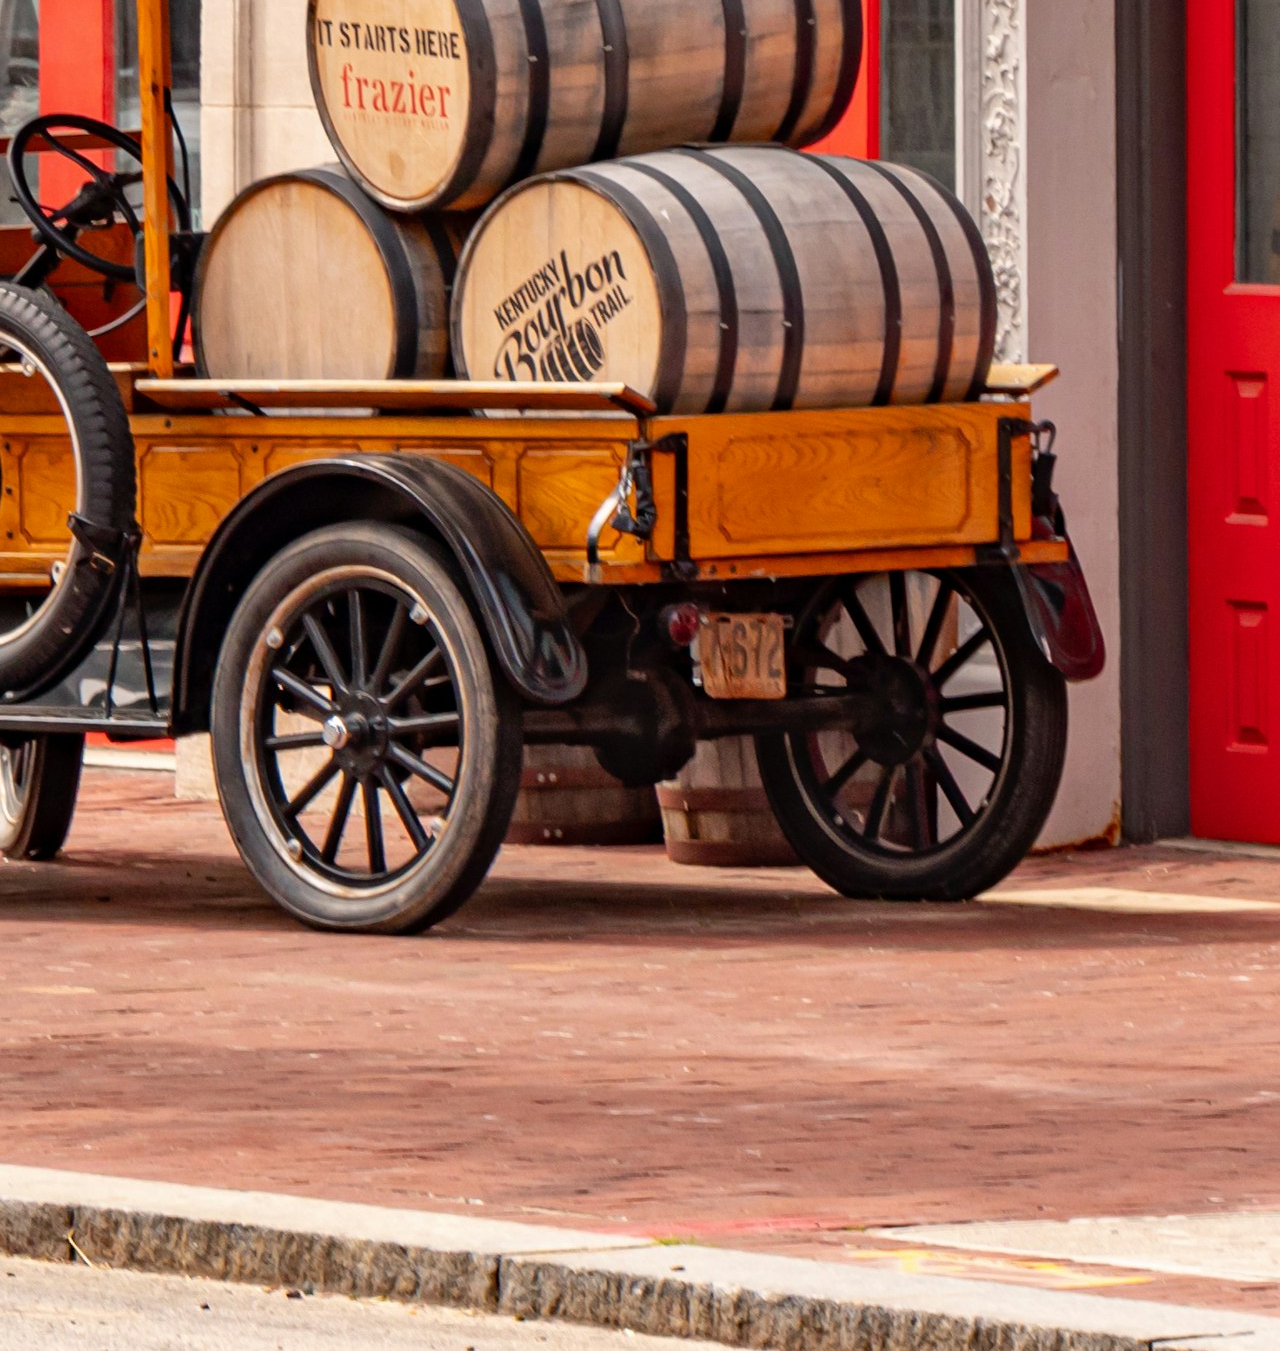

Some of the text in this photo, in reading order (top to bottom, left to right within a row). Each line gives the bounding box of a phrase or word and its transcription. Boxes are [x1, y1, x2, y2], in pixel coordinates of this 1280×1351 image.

[317, 19, 461, 60] IT STARTS HERE
[340, 63, 451, 119] frazier
[493, 258, 561, 330] KENTUCKY
[493, 249, 627, 381] Bourbon
[589, 284, 631, 330] TRAIL
